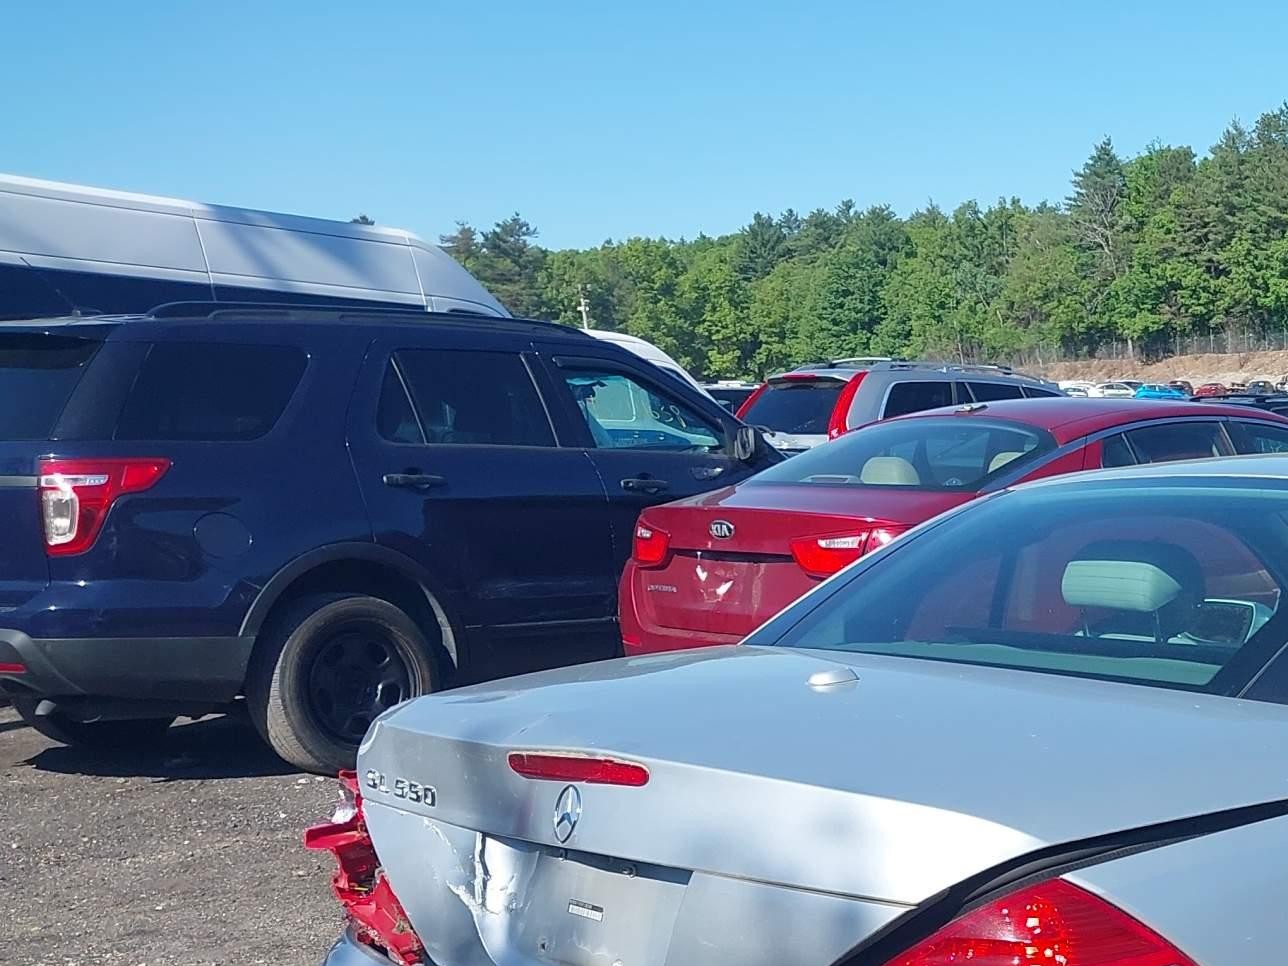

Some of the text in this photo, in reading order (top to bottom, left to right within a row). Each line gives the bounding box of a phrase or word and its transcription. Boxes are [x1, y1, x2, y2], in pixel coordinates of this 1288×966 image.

[710, 523, 731, 537] KIA
[366, 769, 437, 807] SL 550
